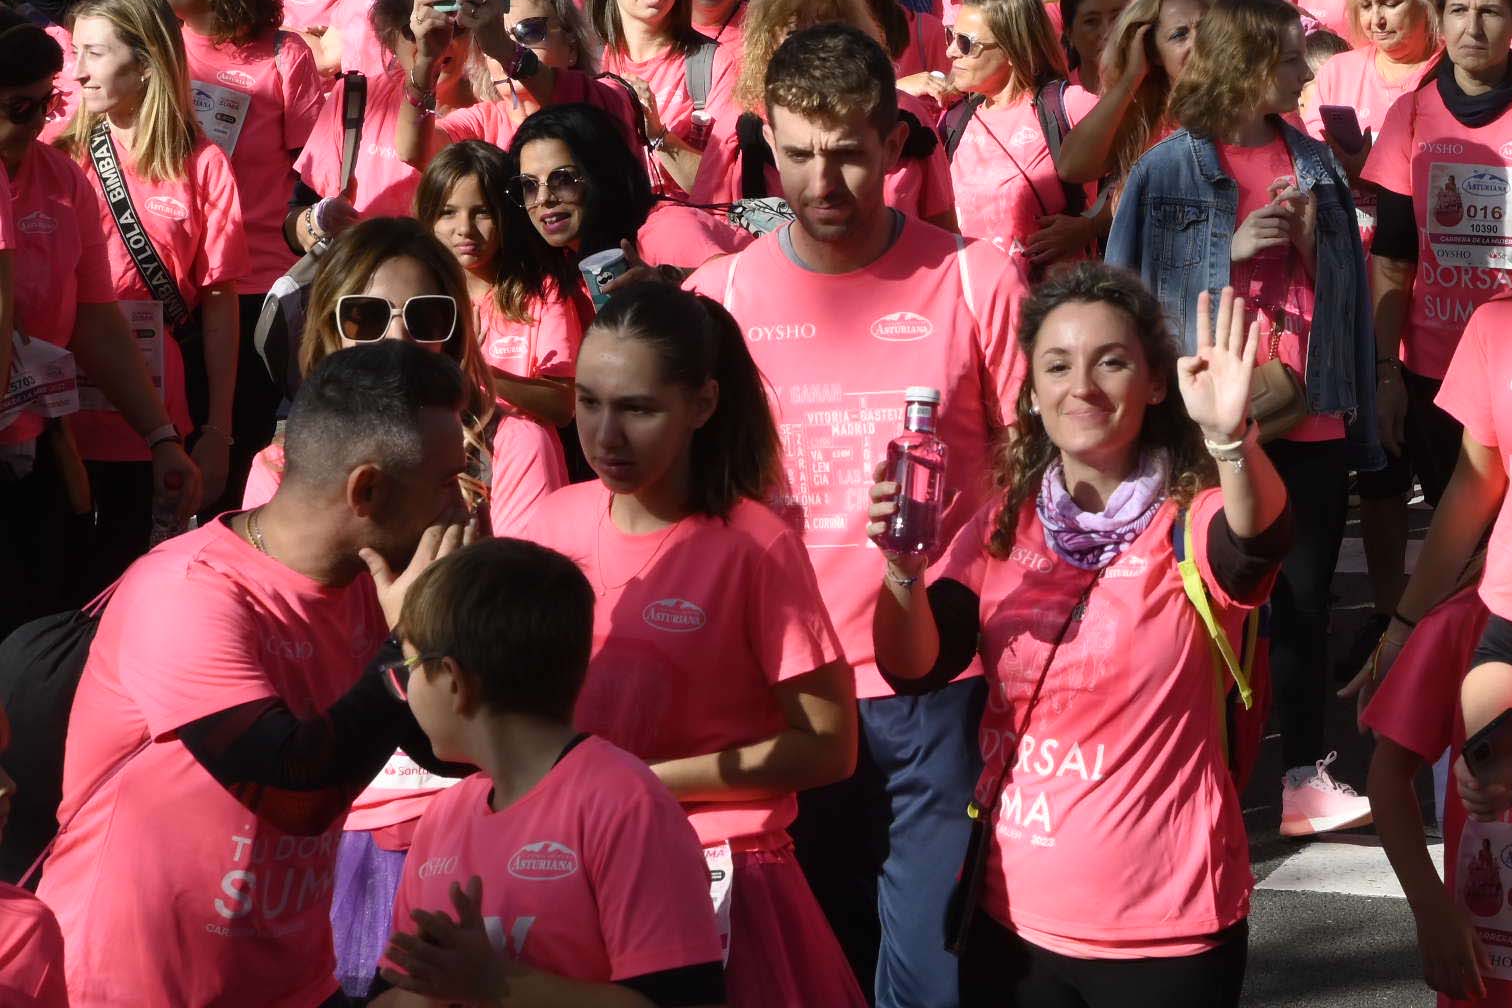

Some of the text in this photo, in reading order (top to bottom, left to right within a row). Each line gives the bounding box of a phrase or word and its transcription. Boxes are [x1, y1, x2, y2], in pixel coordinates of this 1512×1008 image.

[1466, 204, 1503, 220] 016
[1470, 223, 1498, 233] 10390
[1436, 249, 1471, 260] OYSHO
[748, 323, 817, 343] OYSHO
[875, 323, 930, 337] ASTURIANA
[831, 423, 876, 436] MADRID
[512, 857, 575, 872] ASTURIANA
